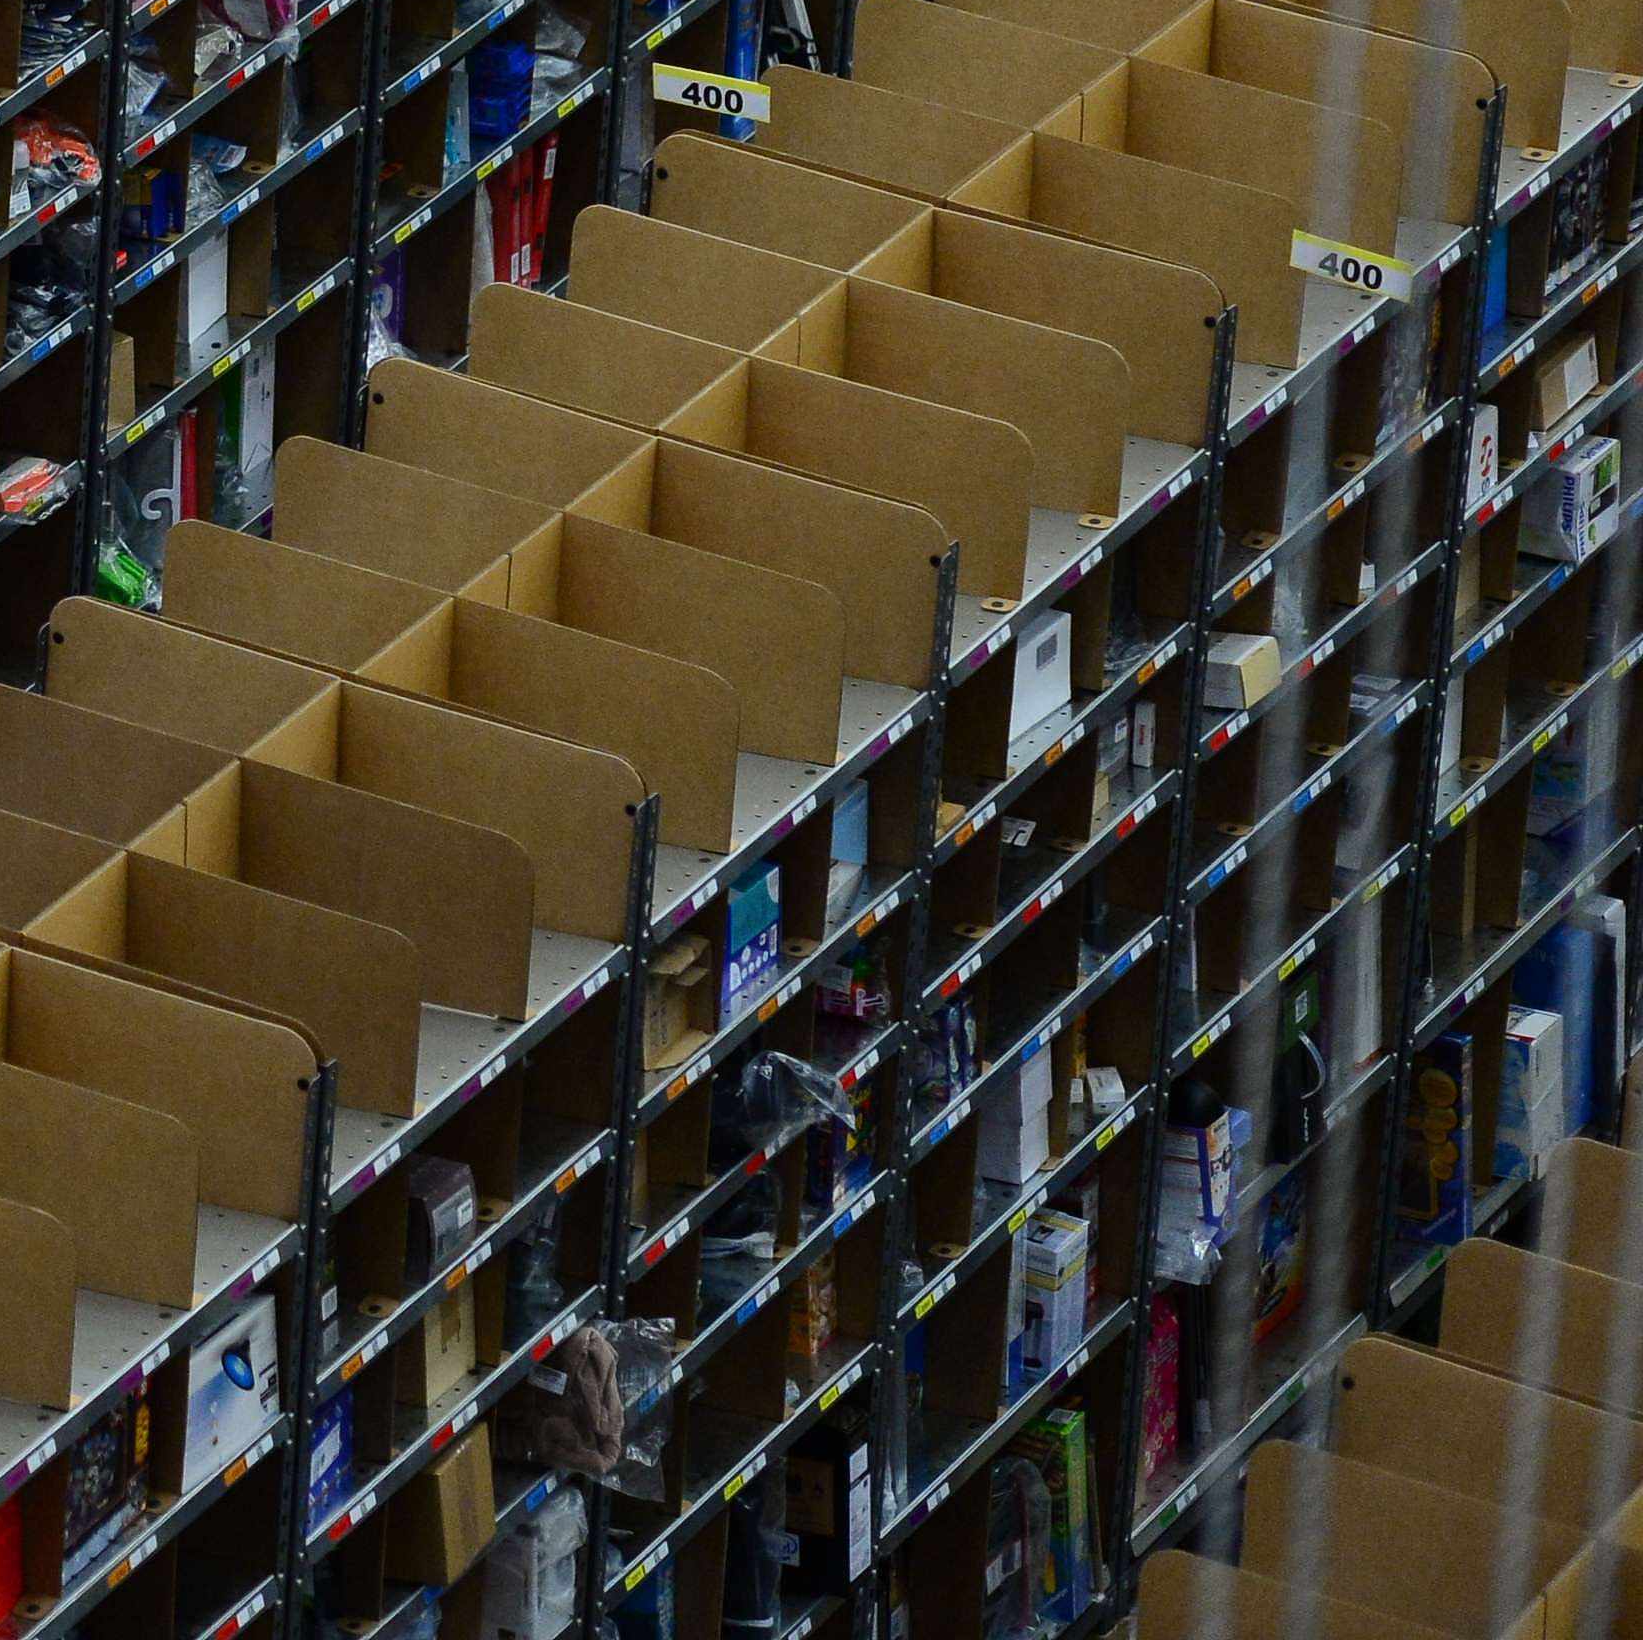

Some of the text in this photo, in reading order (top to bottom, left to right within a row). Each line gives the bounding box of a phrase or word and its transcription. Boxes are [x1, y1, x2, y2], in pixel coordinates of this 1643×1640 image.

[682, 83, 743, 113] 400
[1319, 253, 1382, 289] 400
[1562, 475, 1576, 533] PHILIPS
